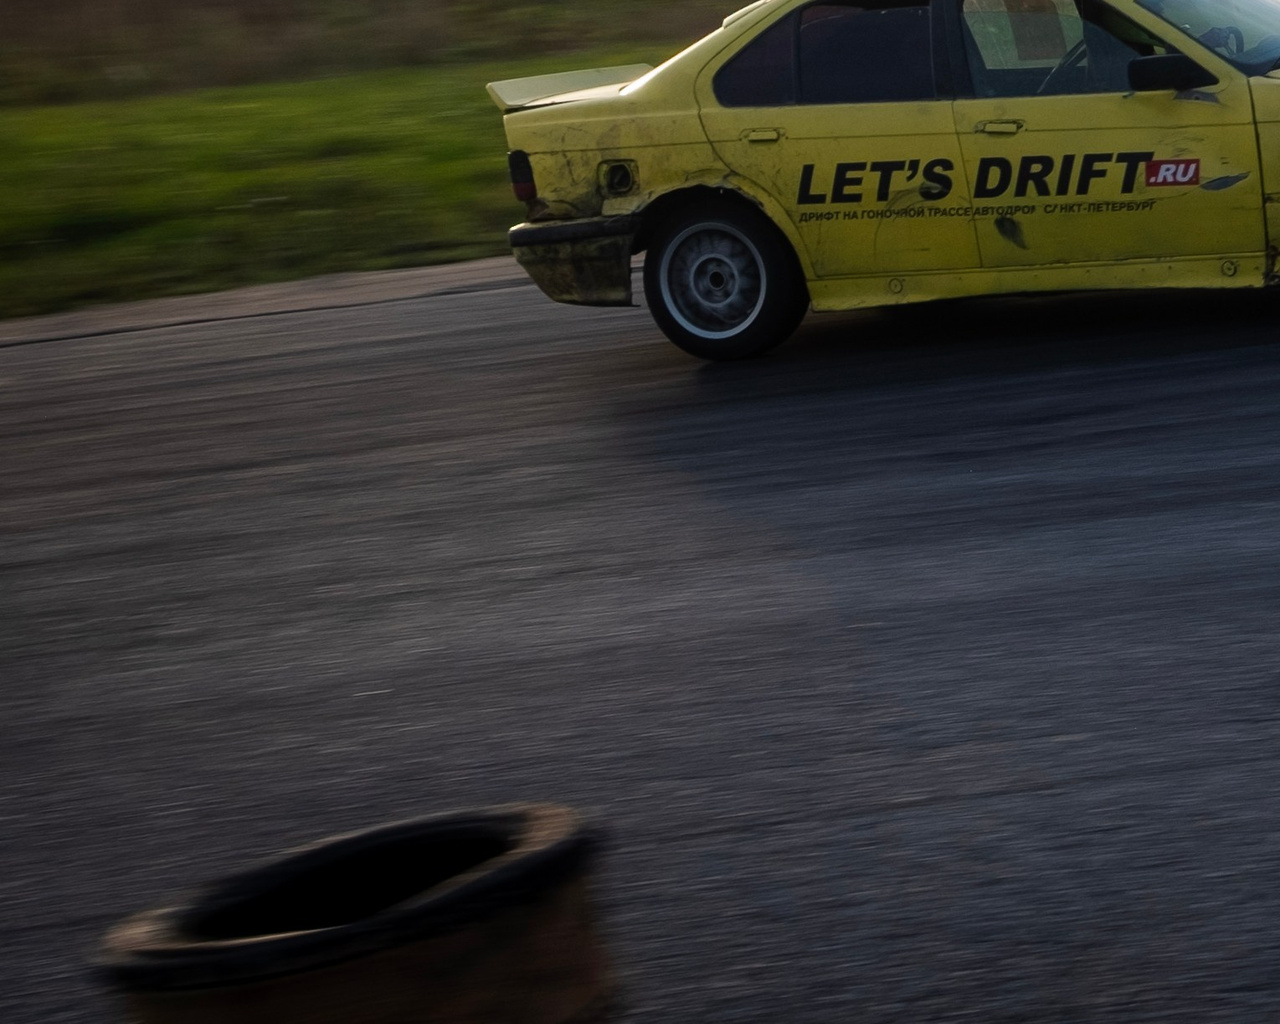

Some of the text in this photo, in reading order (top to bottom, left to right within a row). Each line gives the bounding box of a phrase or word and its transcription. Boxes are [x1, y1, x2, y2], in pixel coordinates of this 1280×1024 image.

[797, 158, 954, 205] LET'S
[974, 151, 1154, 198] DRIFT
[800, 210, 840, 223] ДРИФТ
[843, 210, 859, 221] НА
[861, 207, 925, 220] ГОНОЧНОЙ
[928, 206, 971, 217] ТРАССЕ
